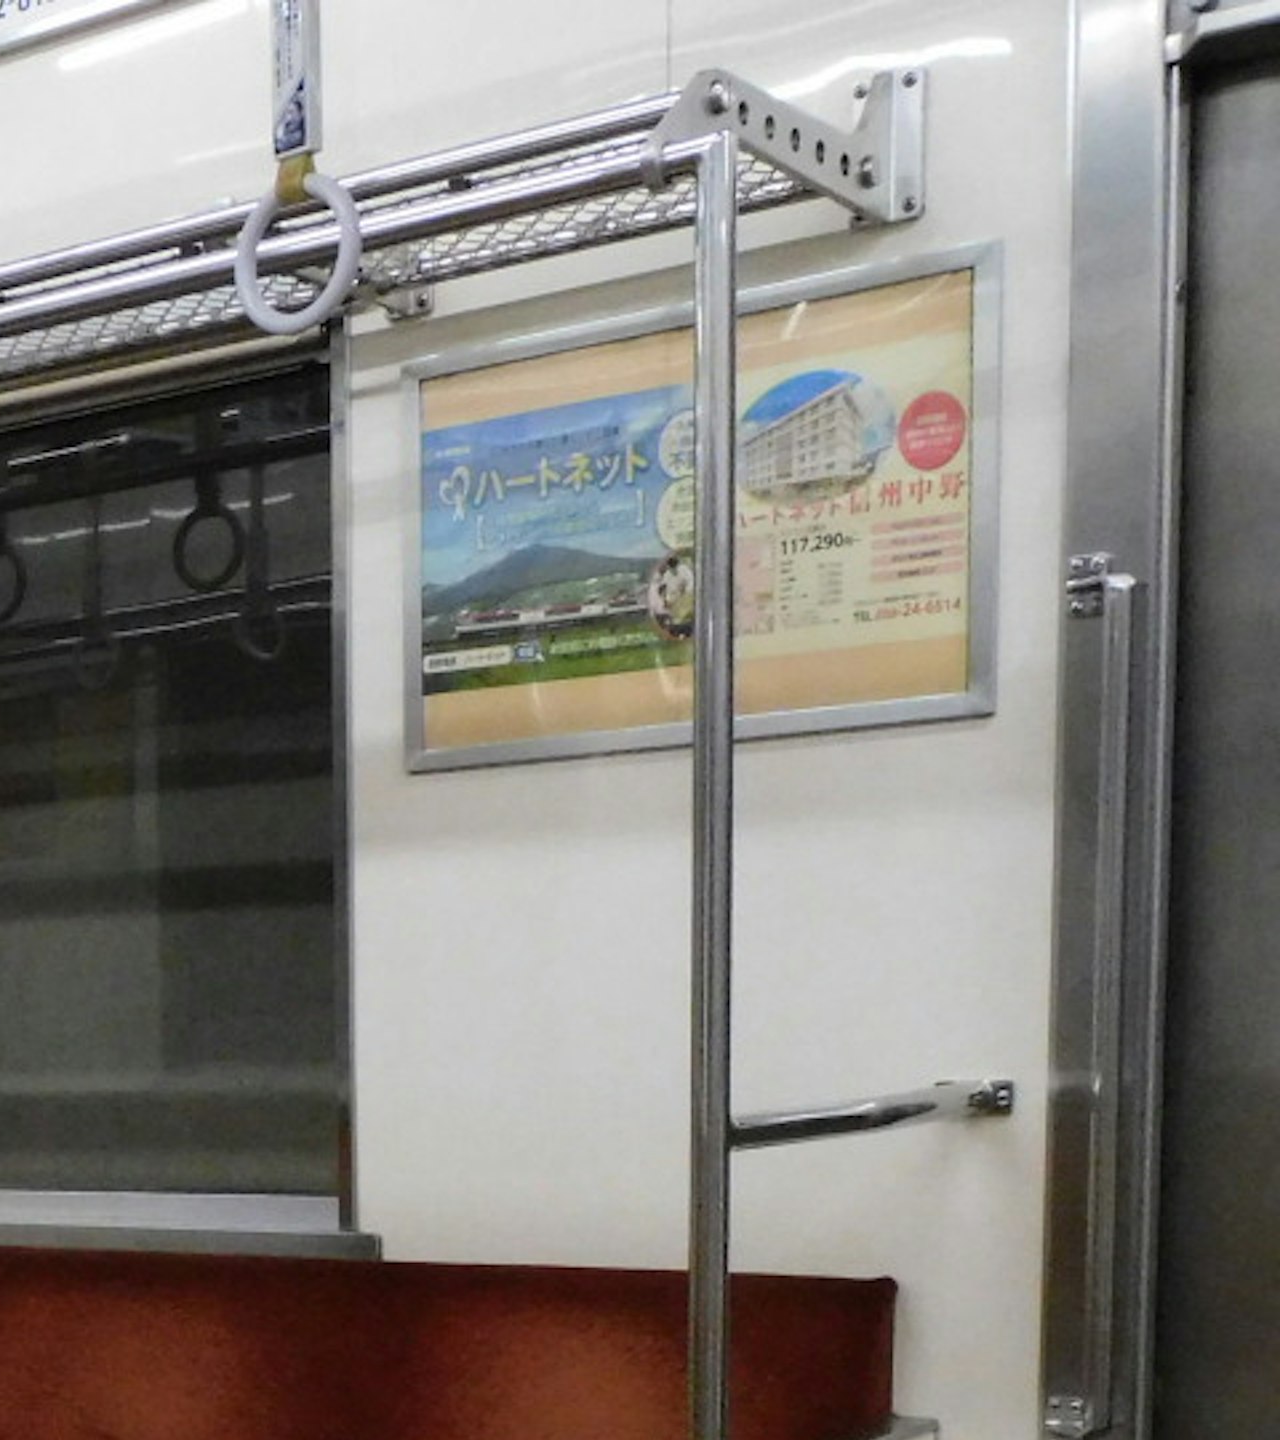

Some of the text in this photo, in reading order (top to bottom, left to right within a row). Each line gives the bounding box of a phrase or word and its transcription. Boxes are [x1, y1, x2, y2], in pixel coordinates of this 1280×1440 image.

[473, 441, 650, 507] ハートネット
